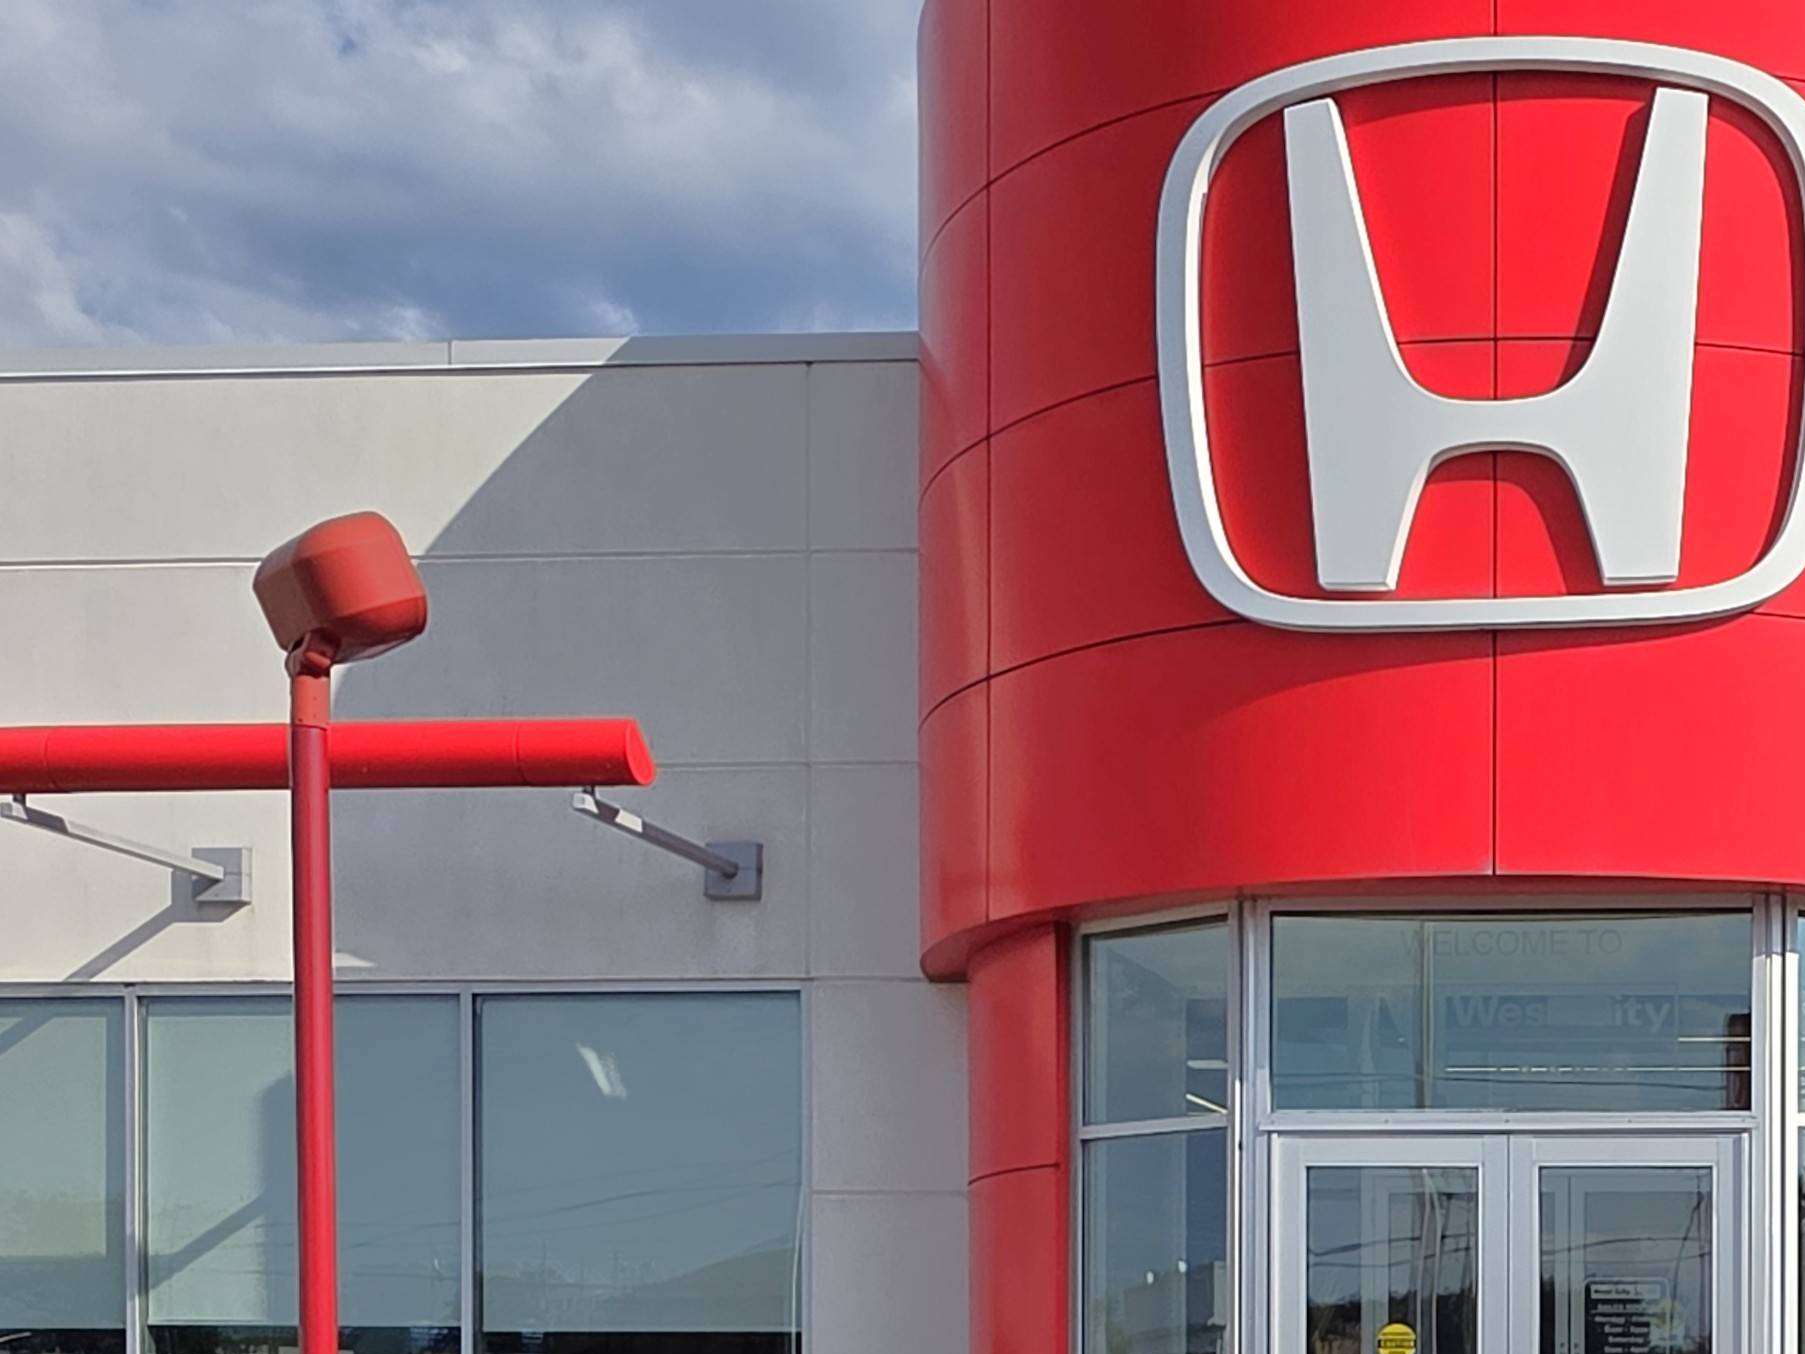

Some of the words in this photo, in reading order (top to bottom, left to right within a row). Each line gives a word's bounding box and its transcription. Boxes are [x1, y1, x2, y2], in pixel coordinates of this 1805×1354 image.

[1400, 929, 1569, 957] WELCOME
[1577, 927, 1624, 955] TO
[1453, 995, 1549, 1027] Wes
